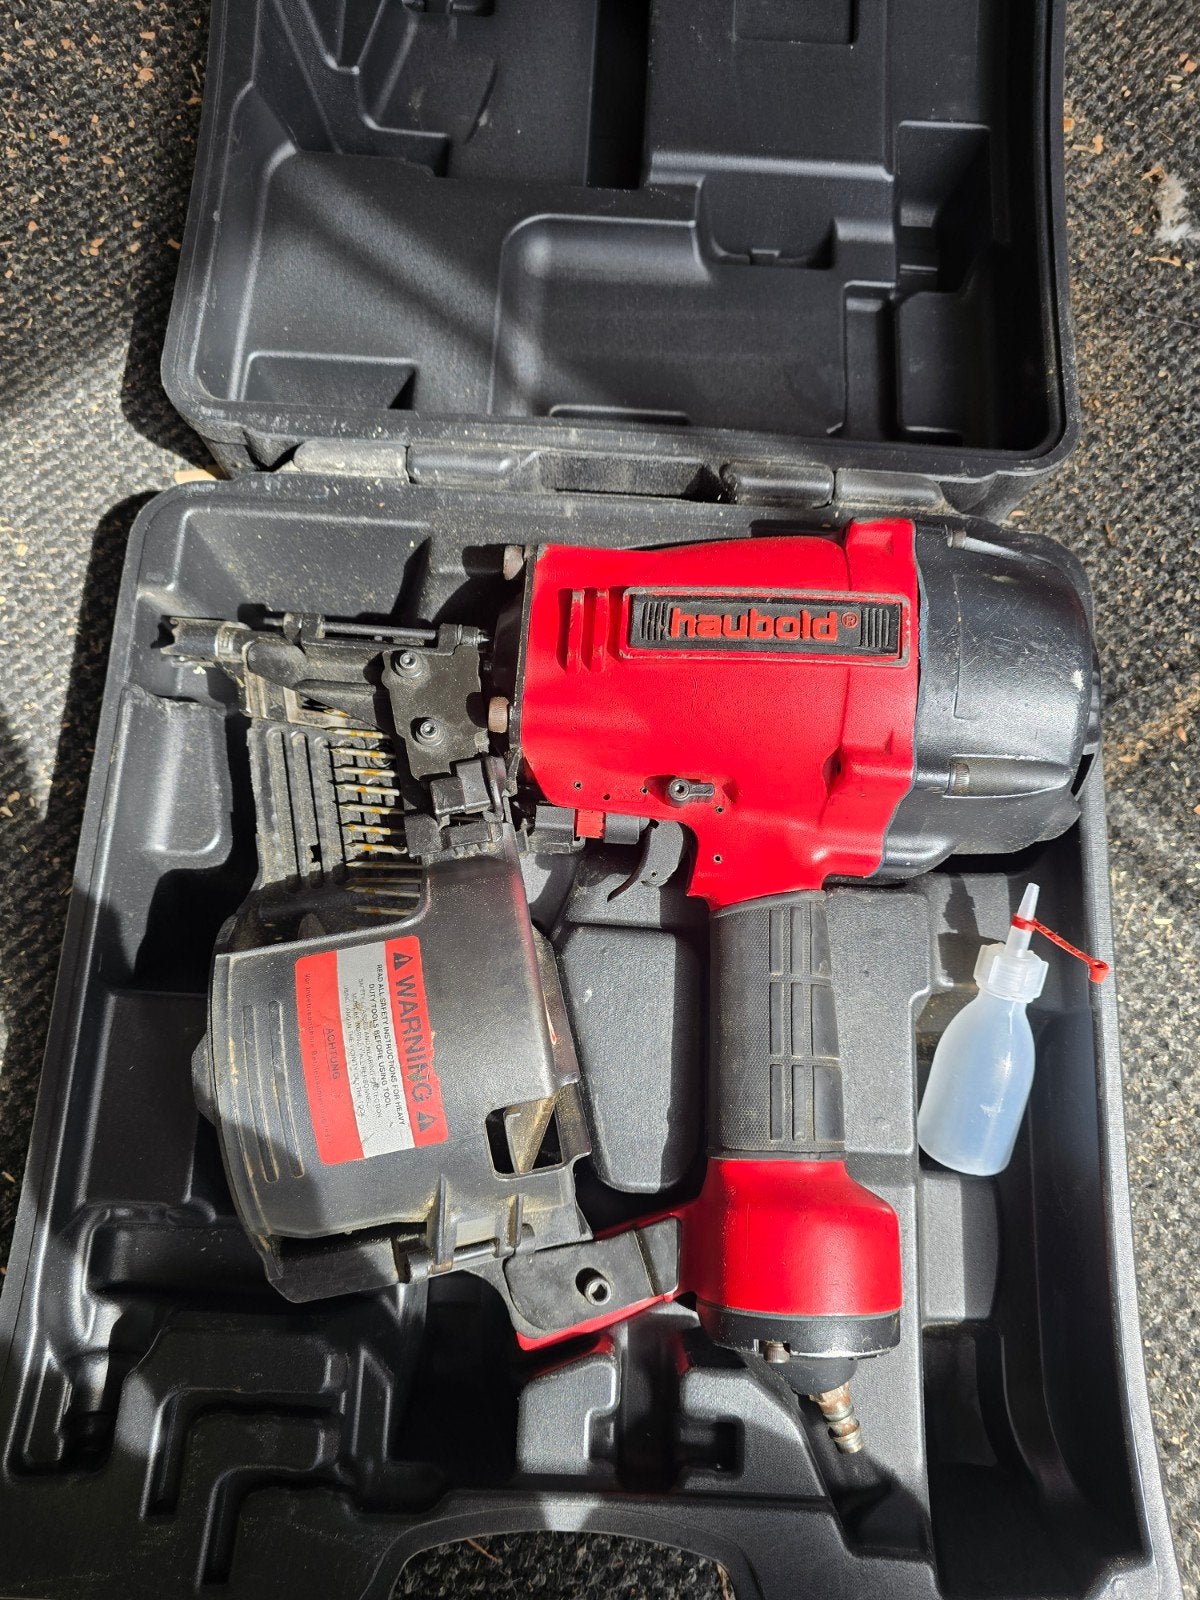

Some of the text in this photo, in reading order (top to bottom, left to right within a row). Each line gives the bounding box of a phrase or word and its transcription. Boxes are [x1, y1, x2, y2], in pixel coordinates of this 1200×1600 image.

[375, 963, 384, 982] READ
[379, 997, 389, 1025] SAFETY
[326, 1027, 340, 1080] ACHTUNG
[367, 983, 391, 1108] DUTY TOOLS BEFORE USING TOOL
[382, 1026, 397, 1083] INSTRUCTIONS
[393, 974, 433, 1102] WARNING
[391, 1084, 400, 1100] FOR
[395, 1101, 404, 1125] HEAVY
